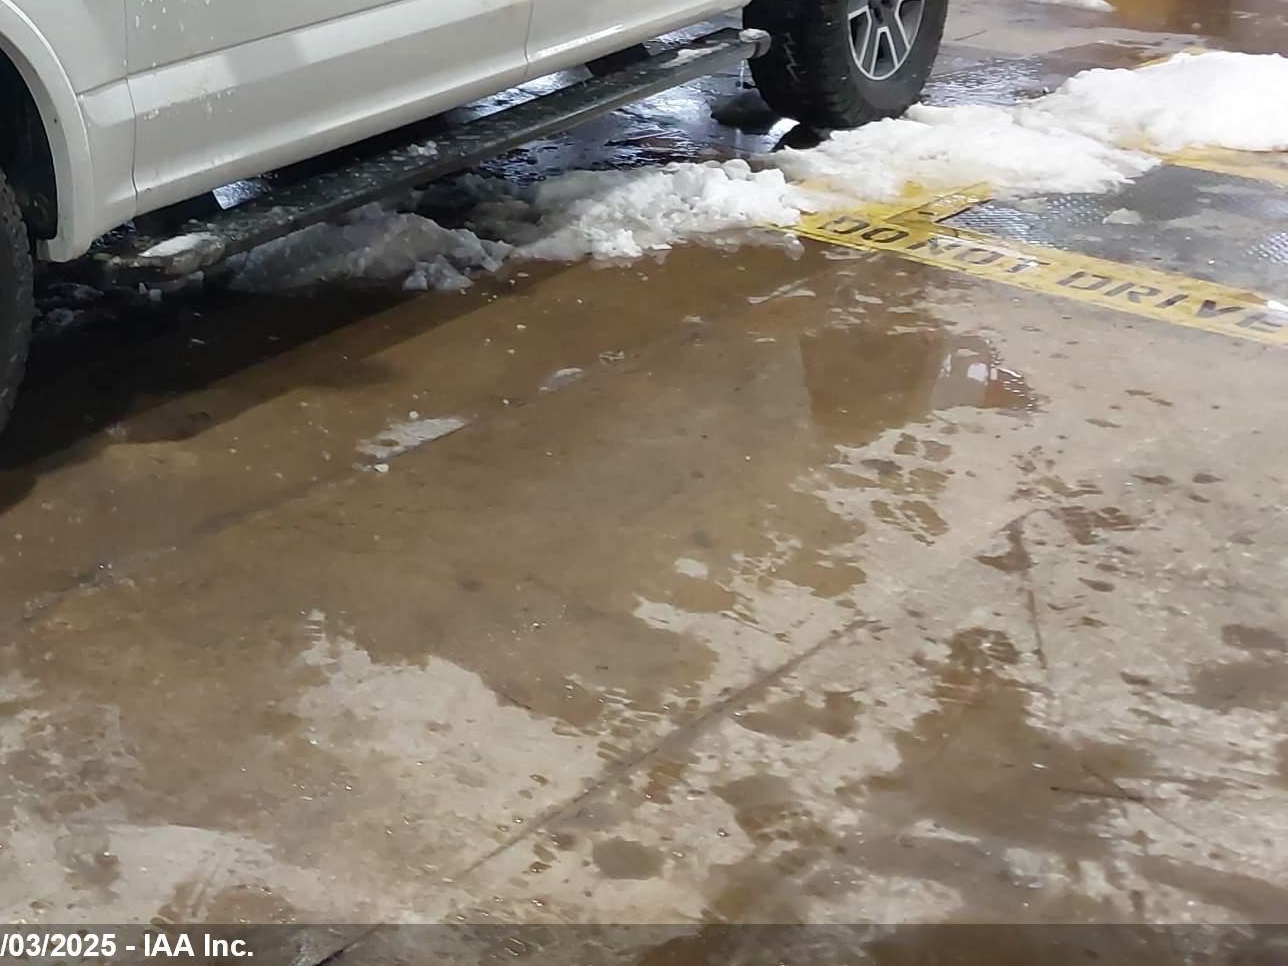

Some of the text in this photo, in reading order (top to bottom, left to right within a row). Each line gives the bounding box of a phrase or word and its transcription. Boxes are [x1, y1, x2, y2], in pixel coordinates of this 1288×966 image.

[818, 215, 1285, 333] DO NOT DRIVE
